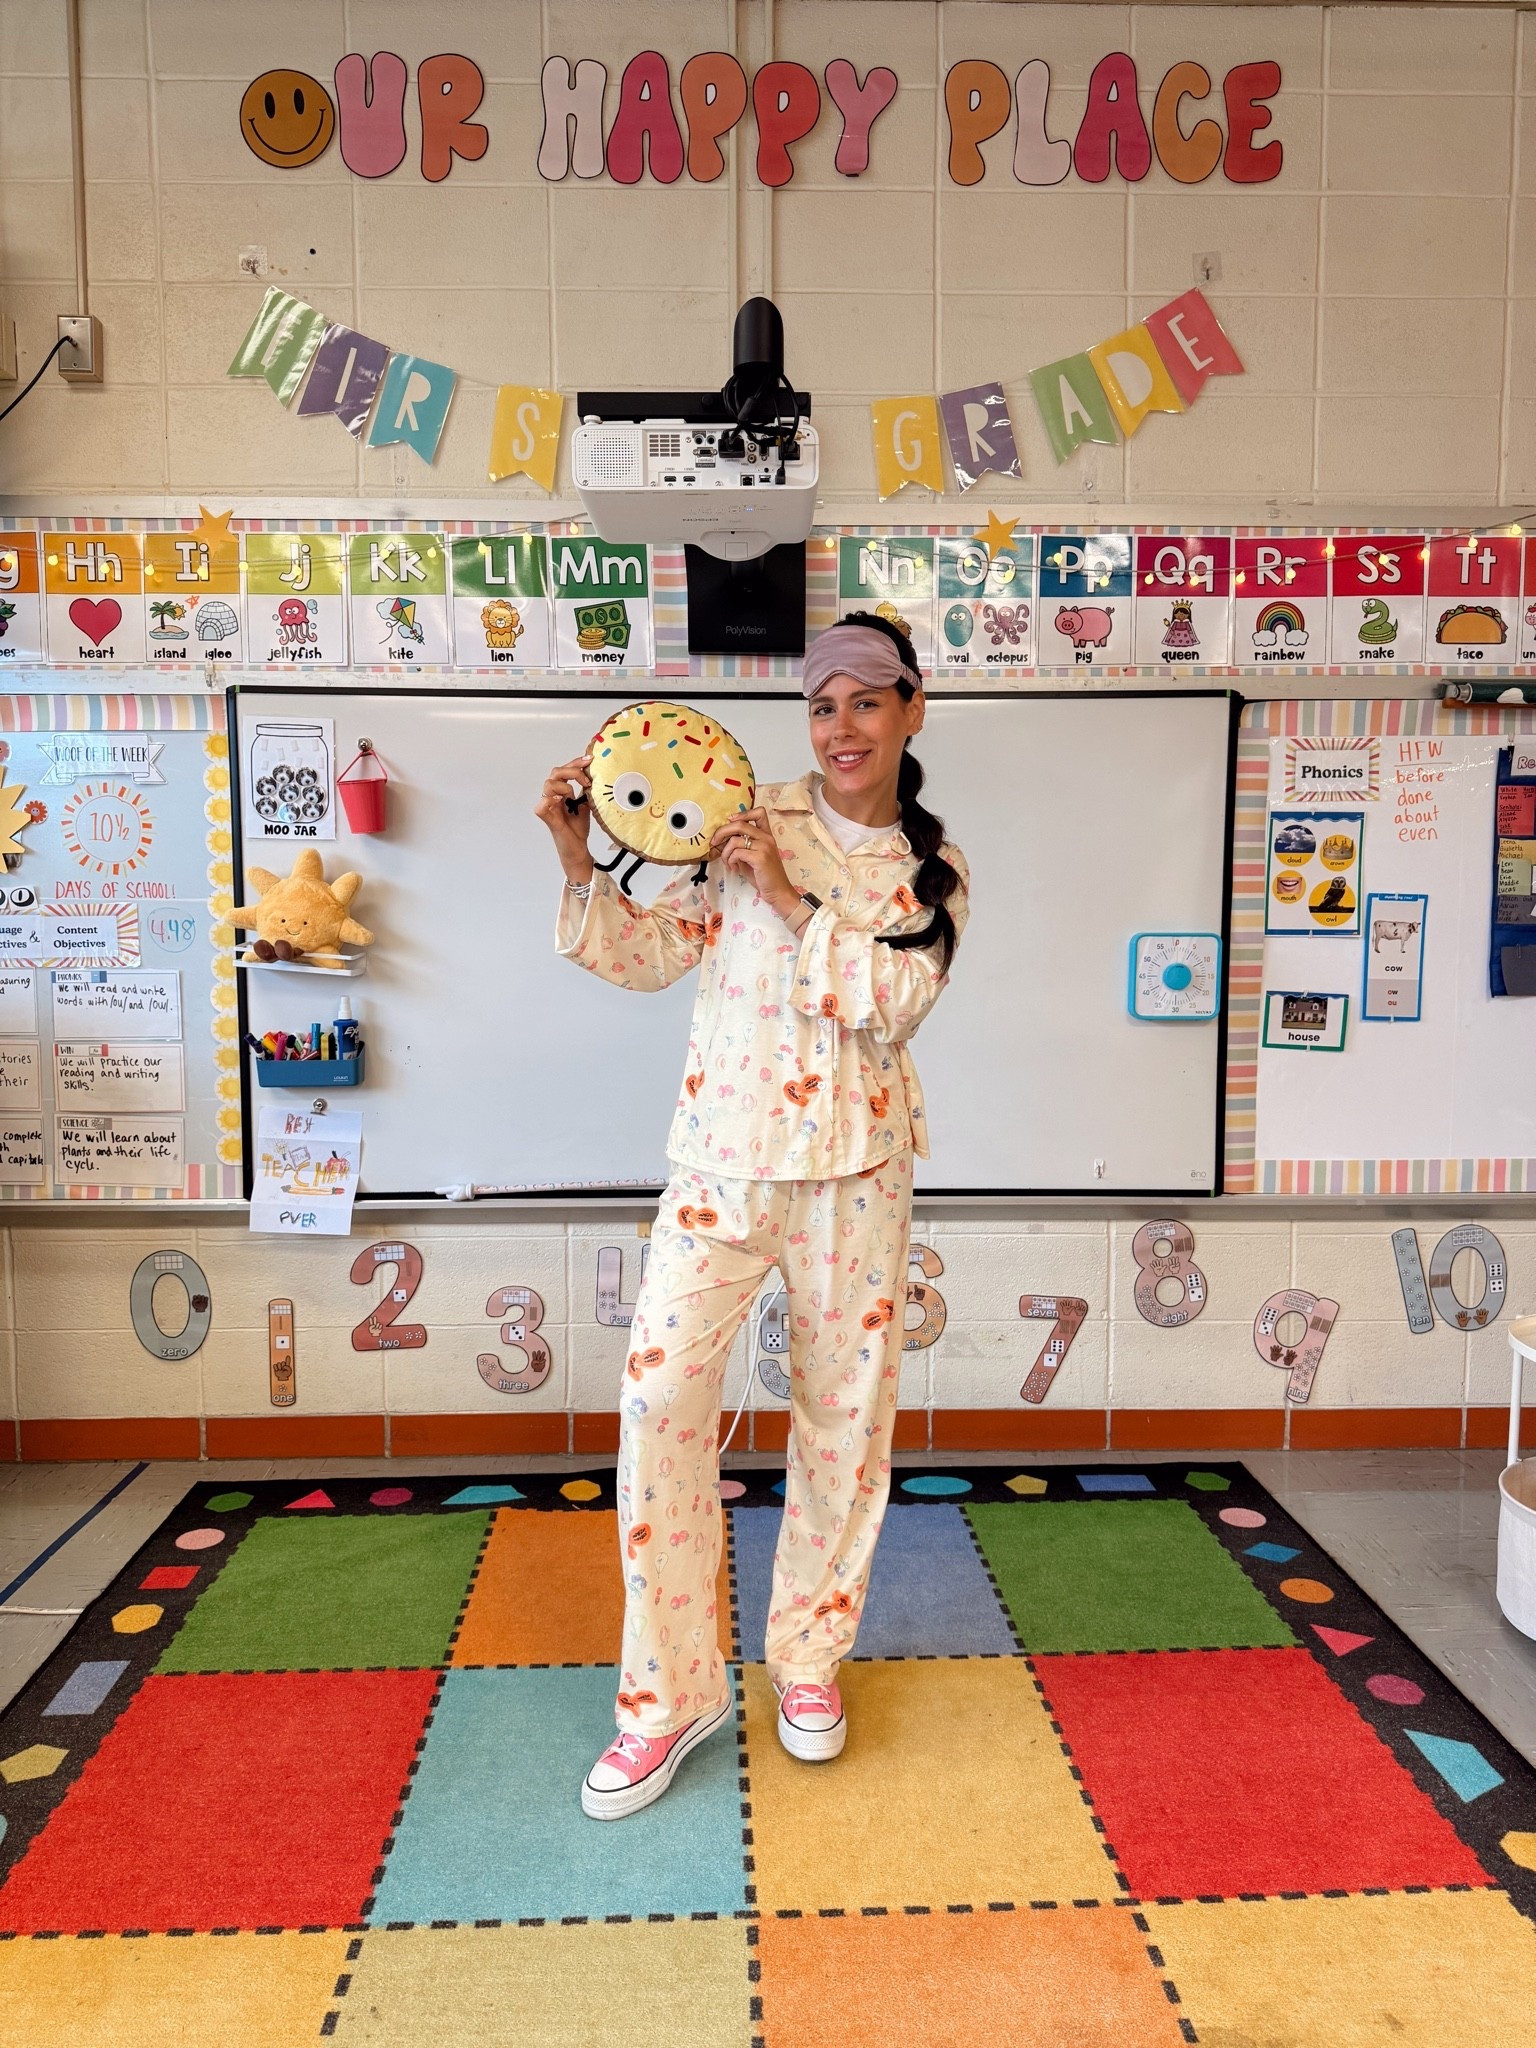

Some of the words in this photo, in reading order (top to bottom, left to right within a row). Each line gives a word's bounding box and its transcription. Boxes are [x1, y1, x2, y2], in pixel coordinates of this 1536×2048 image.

[537, 51, 898, 186] HAPPY
[945, 52, 1283, 186] PLACE
[892, 312, 1215, 472] GRADE
[65, 541, 123, 582] Hh
[279, 542, 312, 591] Jj
[370, 542, 427, 584] Kk
[558, 545, 644, 586] Mm
[858, 546, 916, 586] Nn
[1059, 545, 1113, 593] Pp
[1153, 545, 1215, 593] Qq
[1256, 546, 1307, 586] Rr
[1356, 545, 1401, 585] Ss
[1455, 546, 1498, 585] Tt
[725, 625, 767, 637] PolyVision
[79, 646, 115, 659] heart
[153, 647, 187, 659] island
[204, 647, 233, 660] igloo
[267, 647, 322, 662] jellyfish
[388, 647, 414, 660] kite
[490, 650, 514, 663] lion
[581, 651, 626, 666] money
[946, 652, 970, 663] oval
[986, 652, 1028, 664] octopus
[1075, 651, 1093, 664] pig
[1161, 650, 1200, 662] queen
[1254, 649, 1306, 661] rainbow
[1359, 648, 1395, 660] snake
[1457, 648, 1484, 660] taco
[85, 746, 98, 762] OF
[101, 746, 119, 762] THE
[121, 746, 148, 762] WEEK
[1399, 740, 1443, 762] HFW
[1301, 765, 1364, 779] Phonics
[1396, 767, 1445, 784] before
[1397, 787, 1434, 807] done
[1394, 804, 1440, 824] about
[264, 824, 290, 836] MOO
[293, 825, 317, 836] JAR
[1398, 827, 1438, 842] even
[55, 880, 92, 899] DAYS
[102, 881, 119, 899] OF
[126, 881, 176, 899] SCHOOL!
[57, 926, 98, 935] Content
[53, 939, 106, 949] Objectives
[73, 981, 90, 992] will
[95, 985, 118, 994] read
[121, 985, 138, 995] and
[139, 986, 167, 996] write
[57, 996, 83, 1007] words
[87, 996, 109, 1006] with
[128, 999, 145, 1010] and
[1288, 1031, 1321, 1042] house
[59, 1057, 74, 1067] We
[77, 1057, 95, 1066] will
[100, 1055, 139, 1069] practice
[59, 1067, 95, 1083] reading
[100, 1068, 121, 1078] and
[124, 1067, 159, 1083] writing
[62, 1130, 80, 1143] We
[86, 1130, 107, 1143] will
[111, 1131, 140, 1143] learn
[144, 1131, 177, 1143] about
[61, 1144, 91, 1160] plants
[96, 1146, 113, 1157] and
[113, 1144, 143, 1158] their
[1132, 1218, 1208, 1328] 8
[1391, 1224, 1507, 1334] 10
[349, 1240, 428, 1352] 2
[1027, 1306, 1060, 1318] seven
[1161, 1309, 1189, 1325] eight
[1410, 1314, 1431, 1327] ten
[377, 1337, 401, 1349] two
[476, 1285, 552, 1394] 3
[905, 1337, 922, 1349] six
[1253, 1288, 1340, 1404] 9
[160, 1346, 189, 1357] zero
[268, 1298, 297, 1407] 1
[1019, 1294, 1089, 1404] 7
[498, 1378, 530, 1391] three
[272, 1393, 294, 1403] one
[1287, 1385, 1309, 1400] nine
